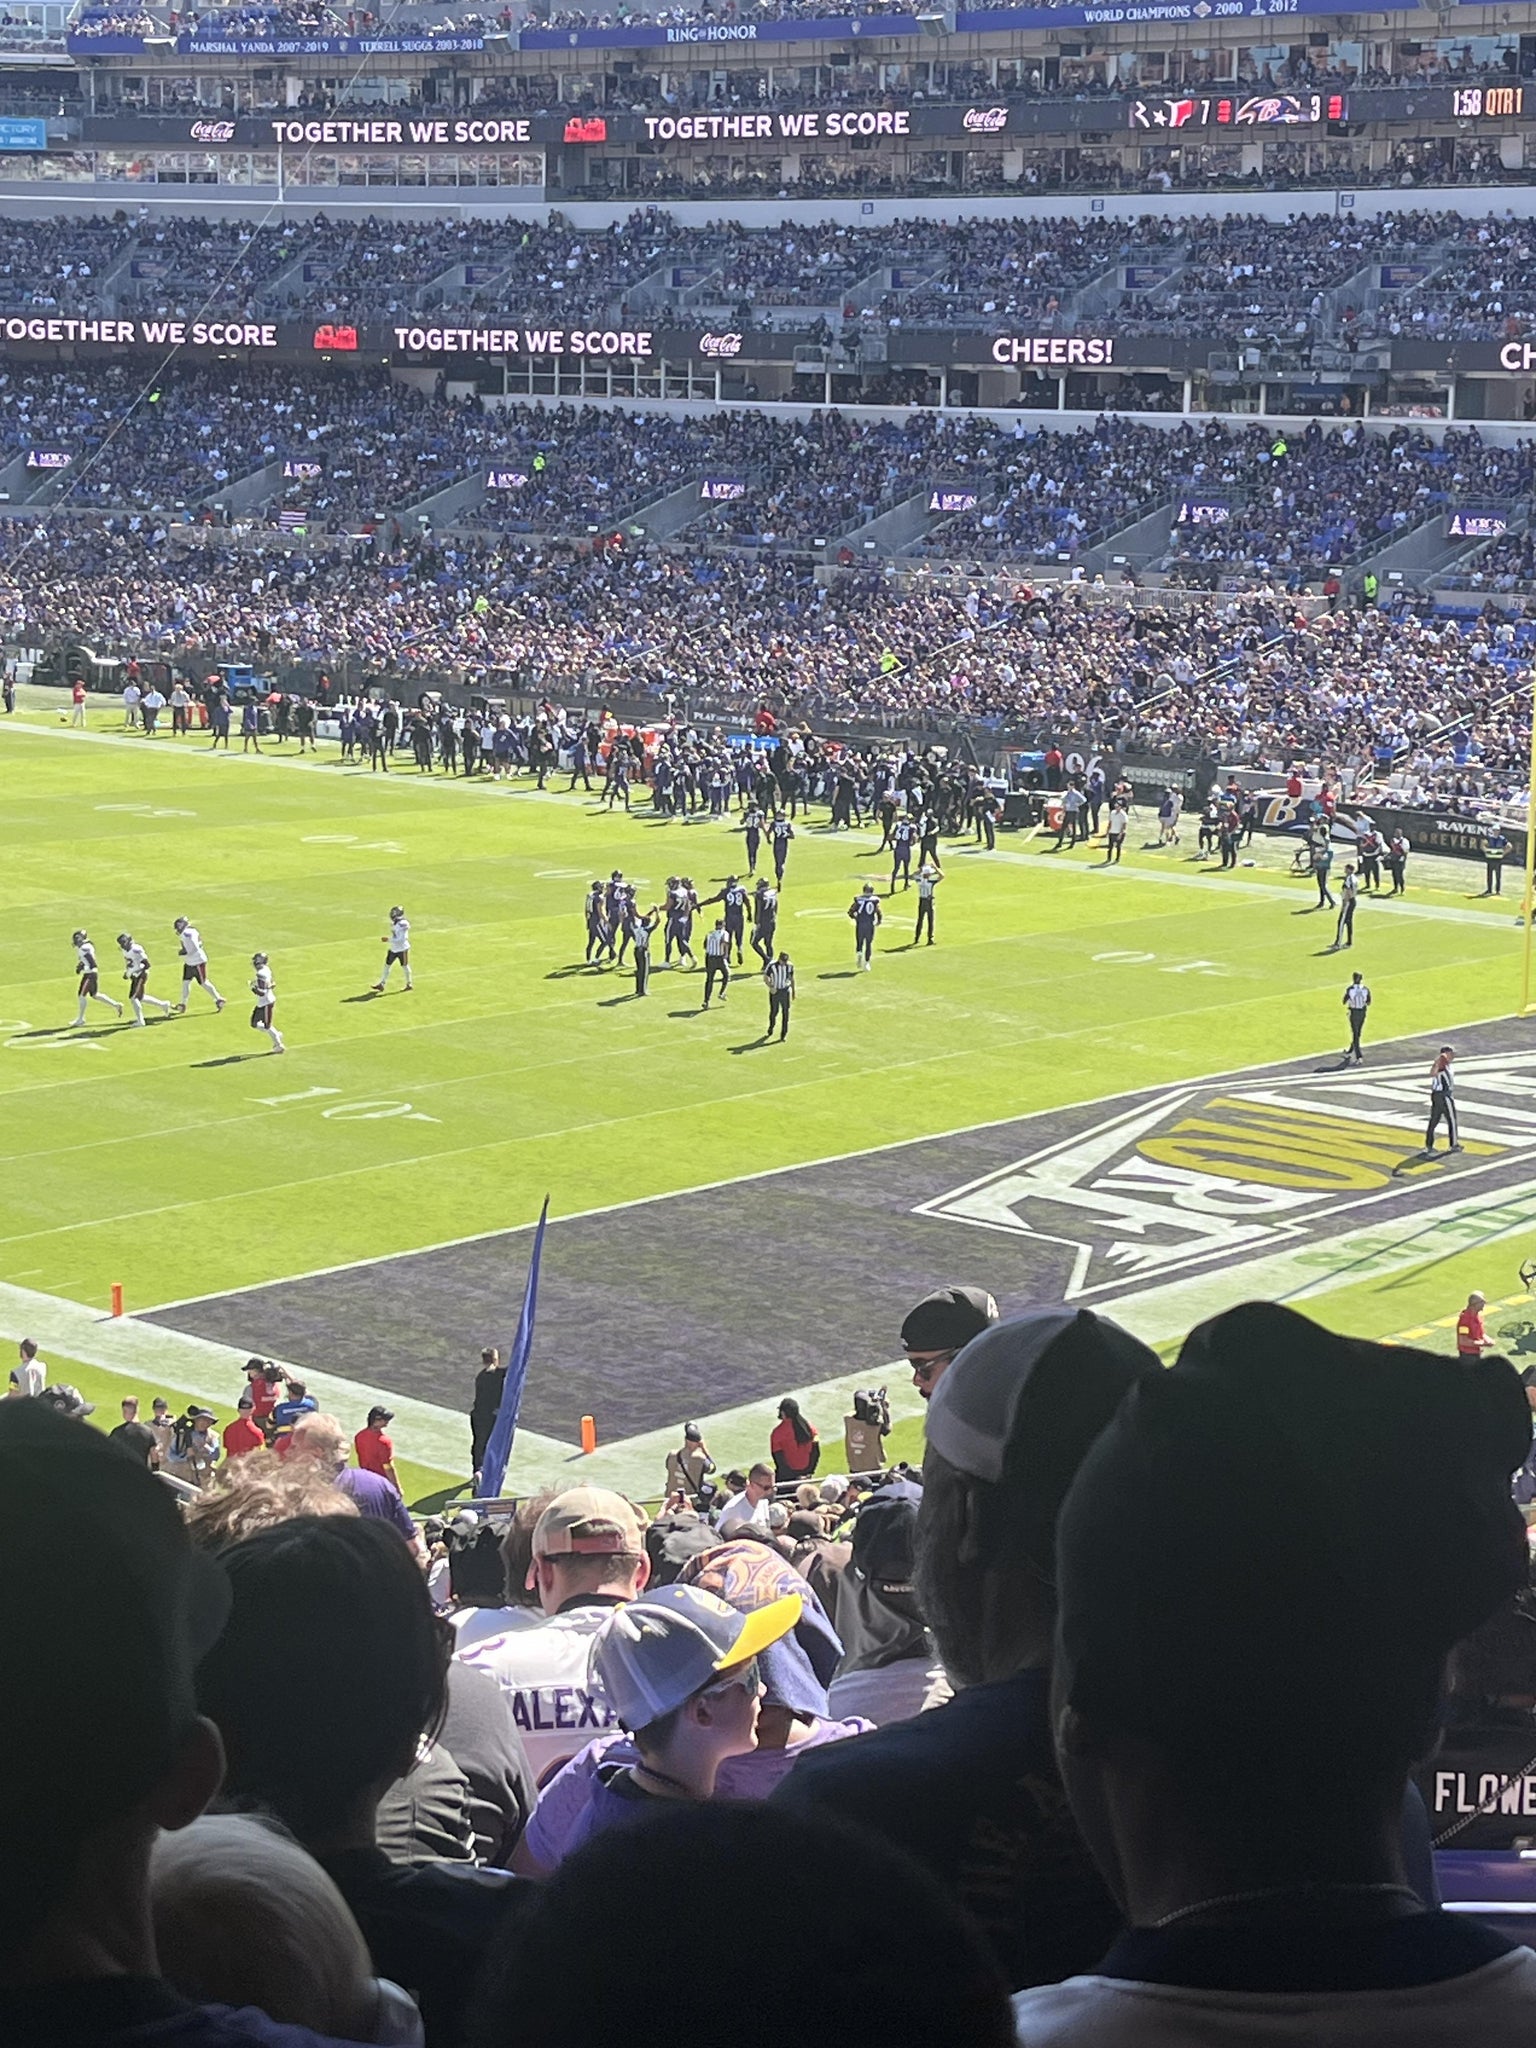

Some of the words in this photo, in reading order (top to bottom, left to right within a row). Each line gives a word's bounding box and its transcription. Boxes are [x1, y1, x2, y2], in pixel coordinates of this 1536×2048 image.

[1084, 10, 1123, 22] WORLD
[1126, 6, 1191, 20] CHAMPIONS
[1214, 2, 1243, 15] 2000
[1269, 0, 1298, 13] 2012
[667, 27, 699, 42] RING
[707, 25, 757, 40] HONOR
[190, 41, 238, 53] MARSHAL
[241, 41, 274, 53] YANDA
[277, 40, 329, 53] 2007-2019
[360, 40, 400, 52] TERRELL
[402, 40, 433, 52] SUGGS
[1310, 95, 1320, 121] 3
[1453, 89, 1482, 115] 1:58
[1485, 88, 1513, 115] QTR
[272, 121, 402, 143] TOGETHER
[409, 121, 449, 142] WE
[454, 120, 530, 142] SCORE
[645, 115, 772, 139] TOGETHER
[779, 114, 819, 137] WE
[825, 111, 910, 135] SCORE
[142, 322, 186, 344] WE
[192, 324, 277, 347] SCORE
[394, 328, 519, 353] TOGETHER
[524, 330, 564, 353] WE
[570, 331, 652, 355] SCORE
[992, 337, 1113, 364] CHEERS!
[726, 893, 743, 906] 98
[858, 901, 875, 915] 70
